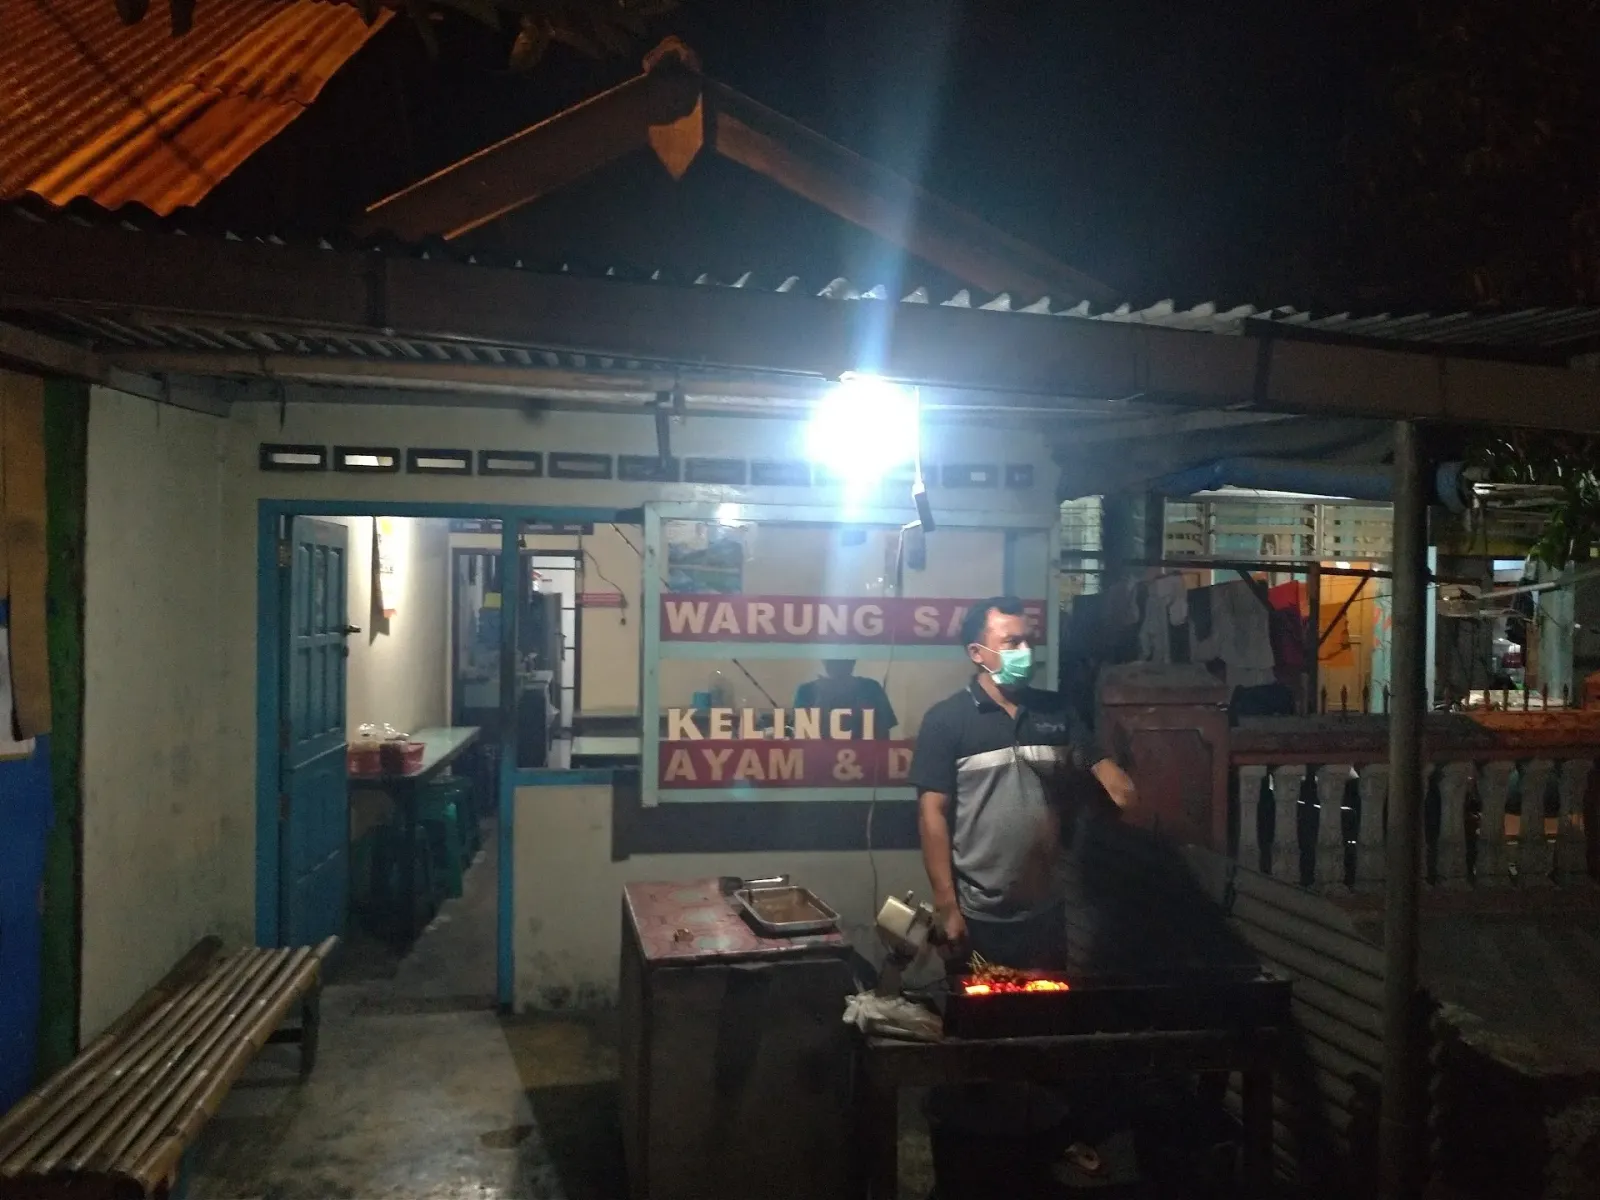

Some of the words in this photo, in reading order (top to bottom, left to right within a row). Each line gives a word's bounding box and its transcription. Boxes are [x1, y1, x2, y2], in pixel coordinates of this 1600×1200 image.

[664, 601, 884, 637] WARUNG
[667, 708, 876, 741] KELINCI
[664, 748, 805, 782] AYAM
[832, 749, 864, 781] &
